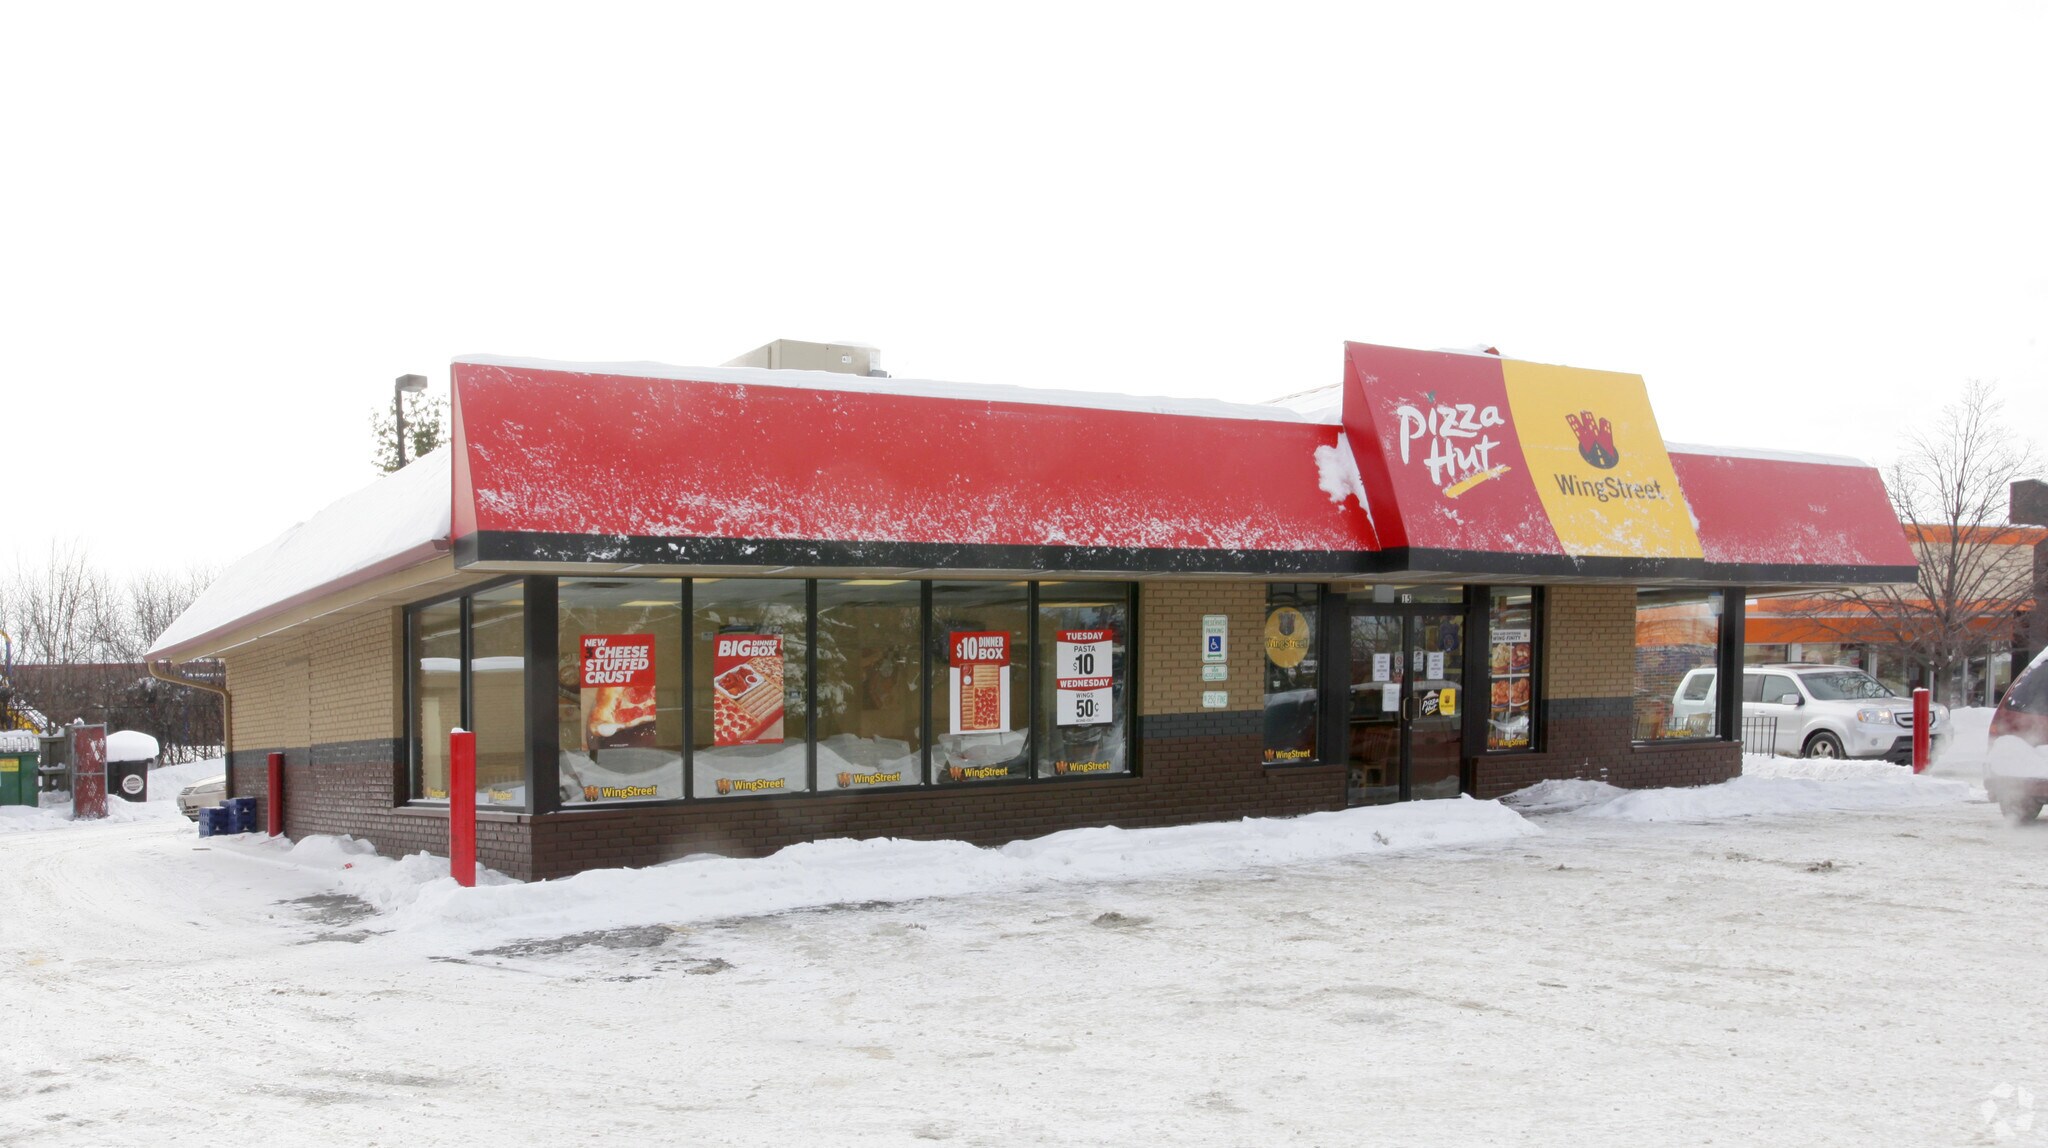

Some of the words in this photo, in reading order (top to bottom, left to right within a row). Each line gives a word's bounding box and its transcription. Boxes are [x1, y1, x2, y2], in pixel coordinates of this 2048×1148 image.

[1423, 434, 1501, 485] Hut
[1554, 473, 1663, 502] WingStreet
[584, 638, 608, 647] NEW
[978, 636, 1004, 647] DINNER
[1066, 632, 1103, 640] TUESDAY
[718, 639, 752, 657] BIG
[956, 636, 978, 660] $10
[1265, 637, 1308, 650] WingStreet
[584, 647, 594, 659] 3
[595, 645, 649, 659] CHEESE
[751, 646, 777, 656] BOX
[978, 647, 1004, 660] BOX
[585, 658, 649, 671] STUFFED
[1072, 653, 1094, 675] $10
[585, 671, 634, 684] CRUST
[1060, 679, 1109, 688] WEDNESDAY
[1275, 749, 1310, 760] WingStreet
[964, 767, 1008, 778] WingStreet
[1069, 761, 1110, 772] WingStreet
[734, 778, 785, 790] WingStreet
[853, 772, 901, 784] WingStreet
[602, 785, 657, 799] WingStreet
